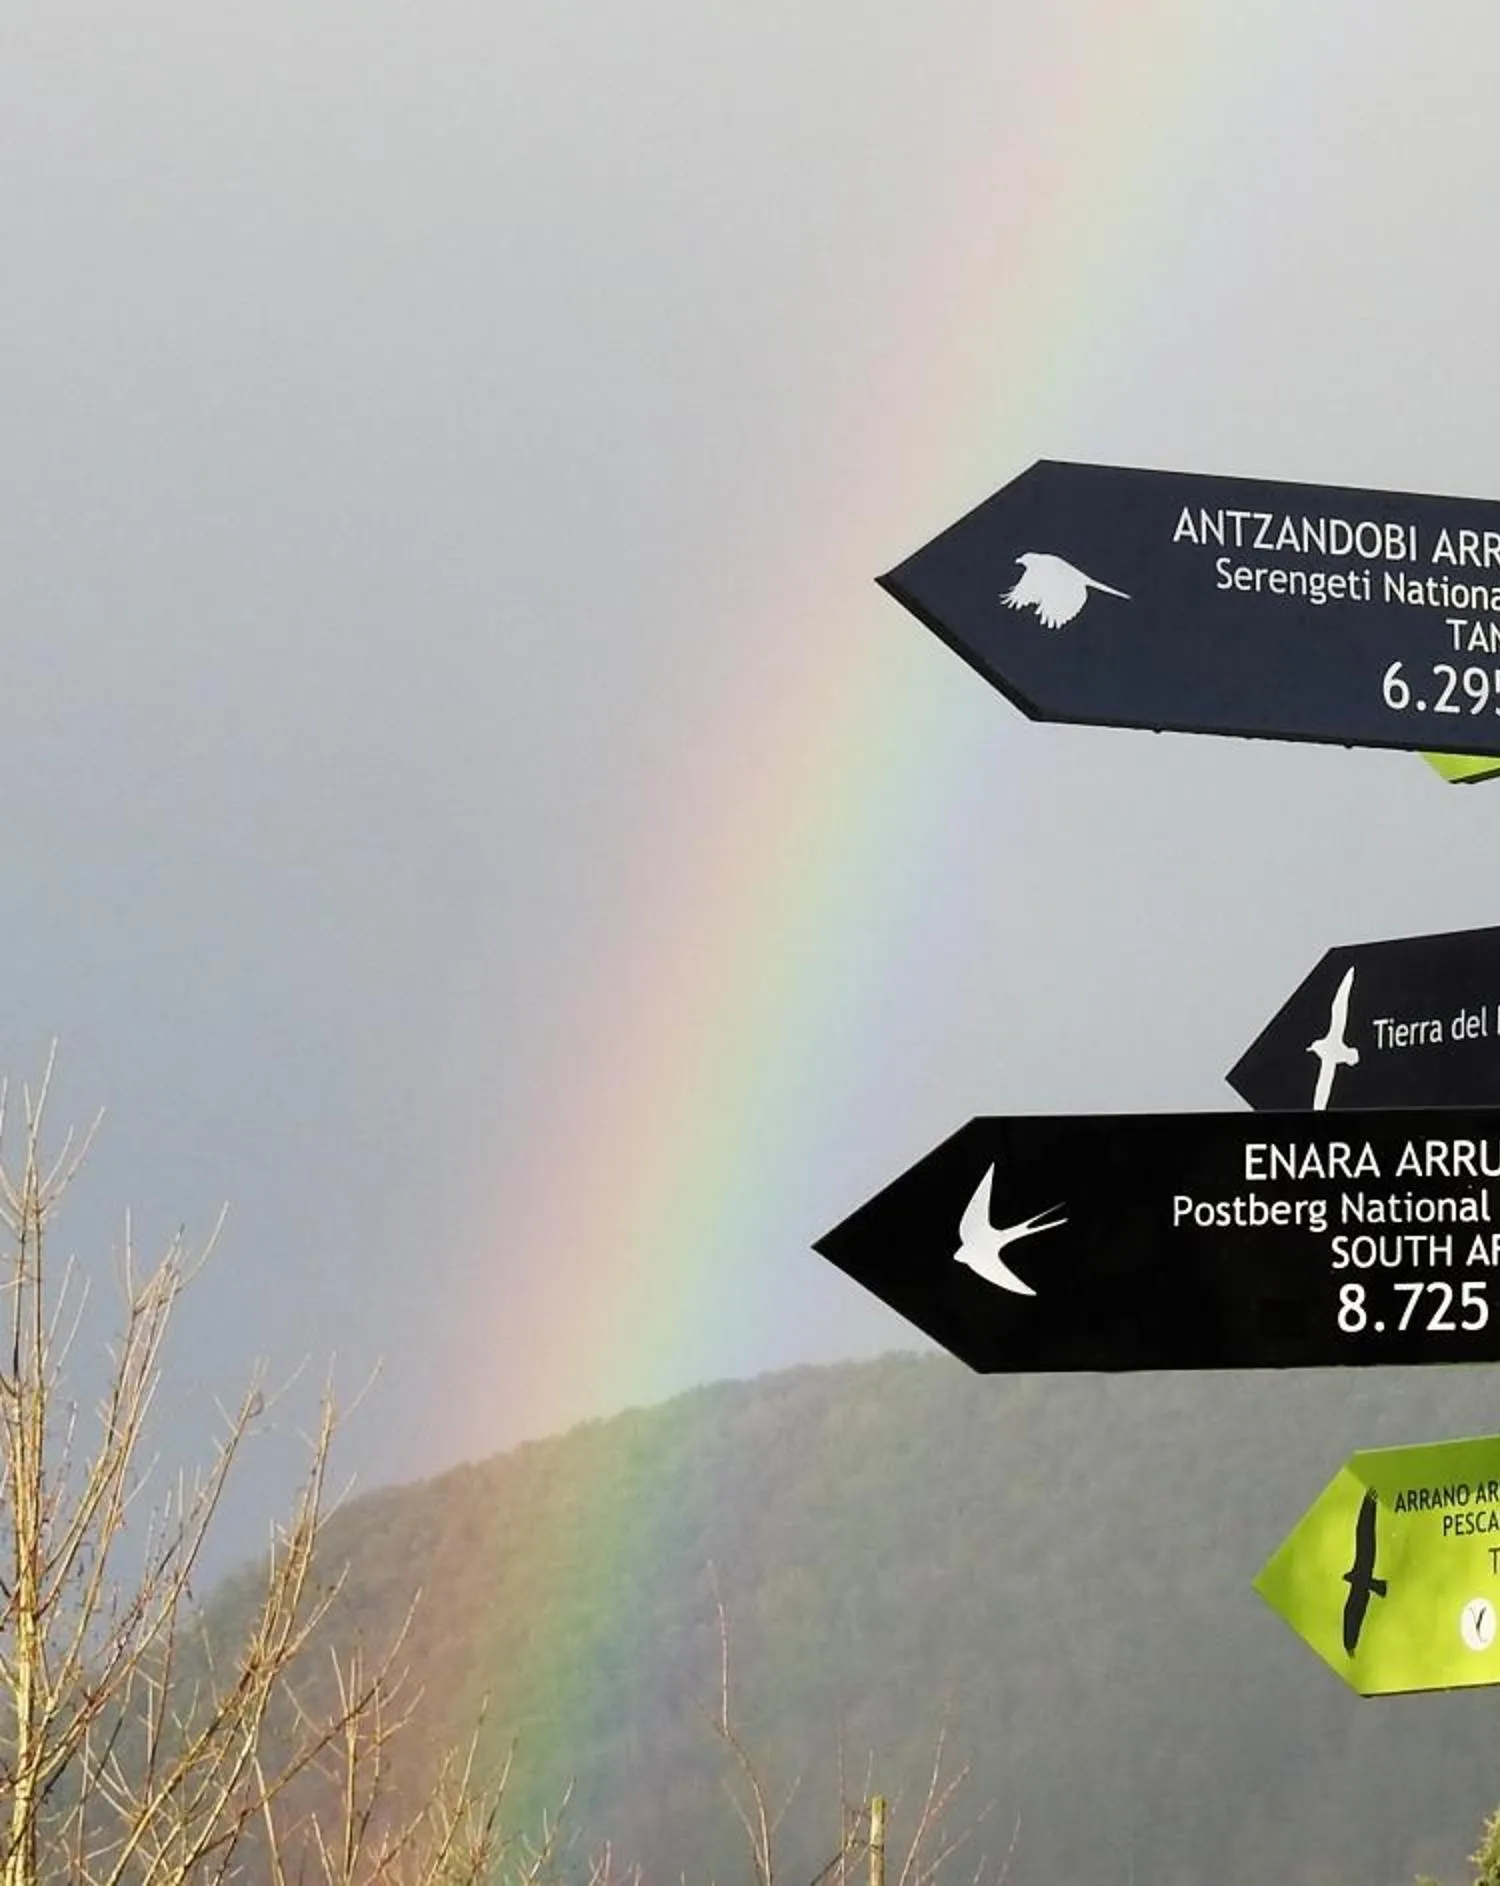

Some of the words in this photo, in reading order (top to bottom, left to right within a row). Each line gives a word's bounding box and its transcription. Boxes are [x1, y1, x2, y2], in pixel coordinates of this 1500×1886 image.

[1173, 507, 1417, 562] ANTZANDOBI
[1216, 558, 1371, 605] Serengeti
[1373, 1018, 1442, 1049] Tierra
[1451, 1006, 1487, 1042] del
[1245, 1142, 1381, 1181] ENARA
[1172, 1194, 1327, 1233] Postberg
[1341, 1190, 1491, 1225] National
[1330, 1234, 1453, 1269] SOUTH
[1337, 1281, 1489, 1333] 8.725
[1394, 1483, 1469, 1513] ARRANO
